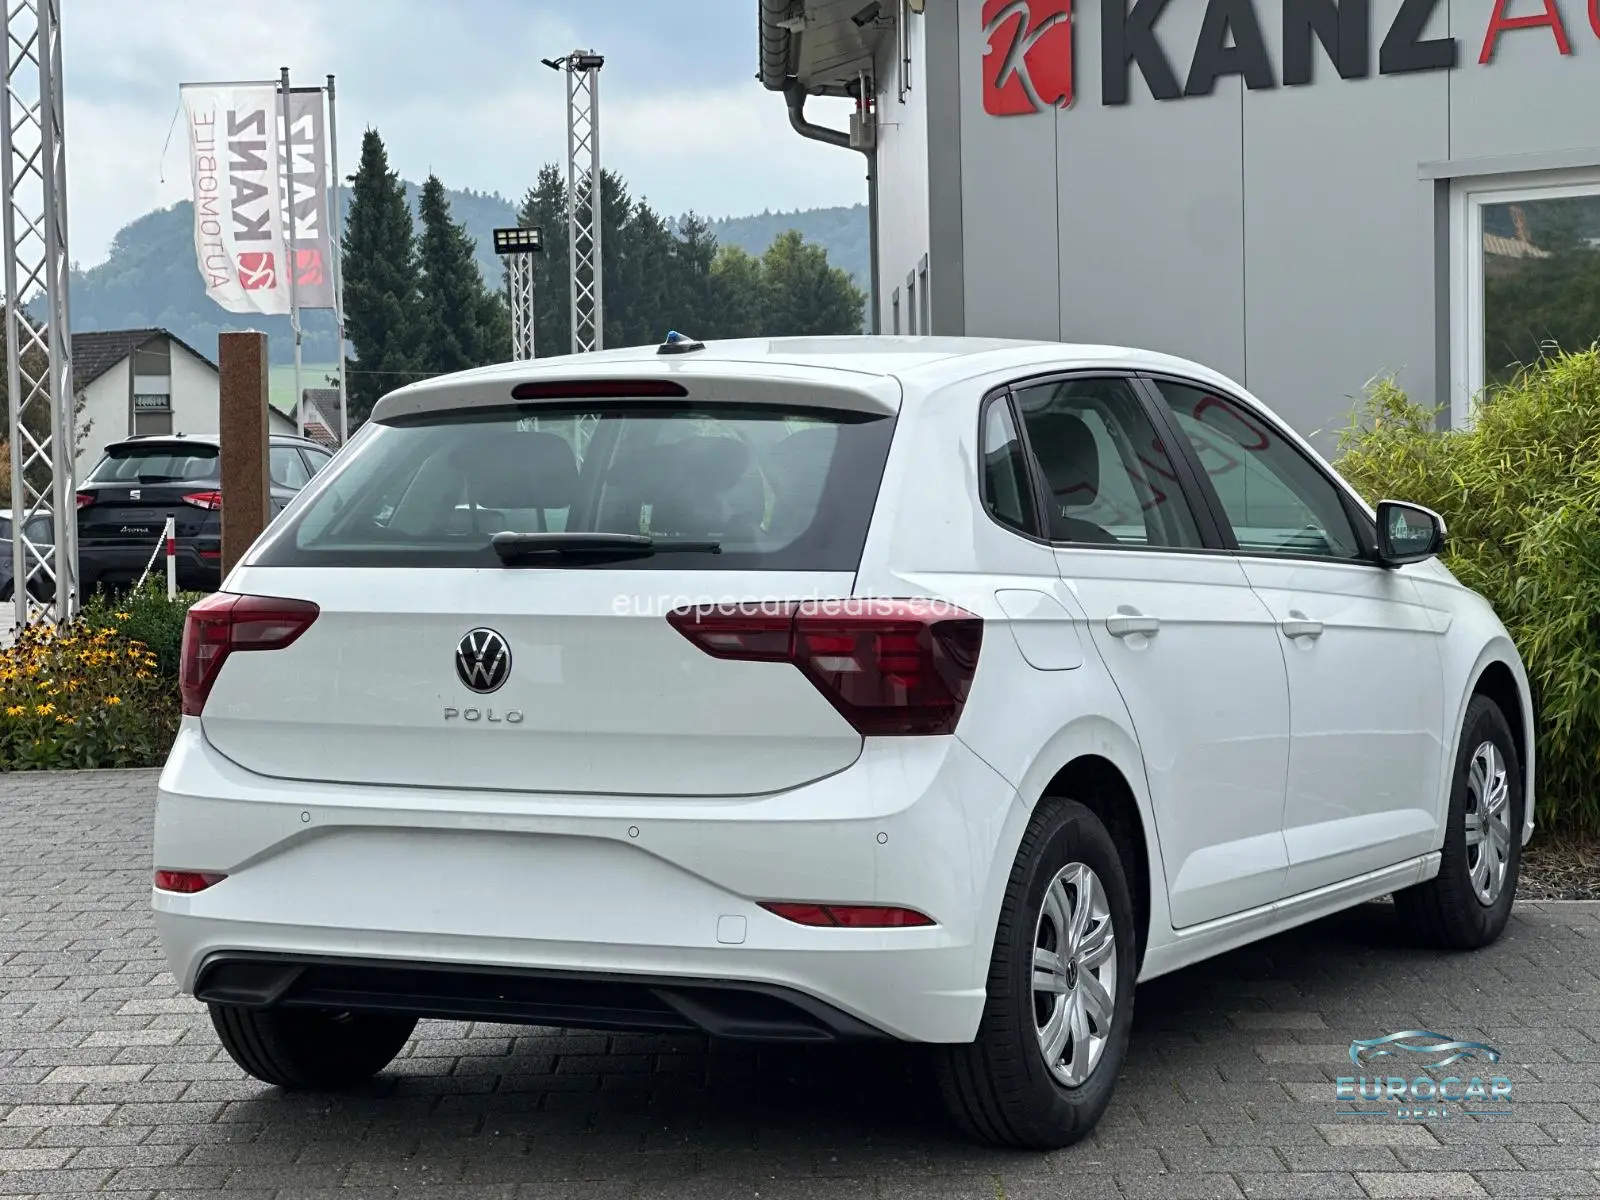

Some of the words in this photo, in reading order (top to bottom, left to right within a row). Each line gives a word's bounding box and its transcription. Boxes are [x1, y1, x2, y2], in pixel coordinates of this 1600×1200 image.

[1100, 0, 1455, 106] KANZ
[1478, 0, 1600, 64] A
[444, 707, 524, 724] POLO
